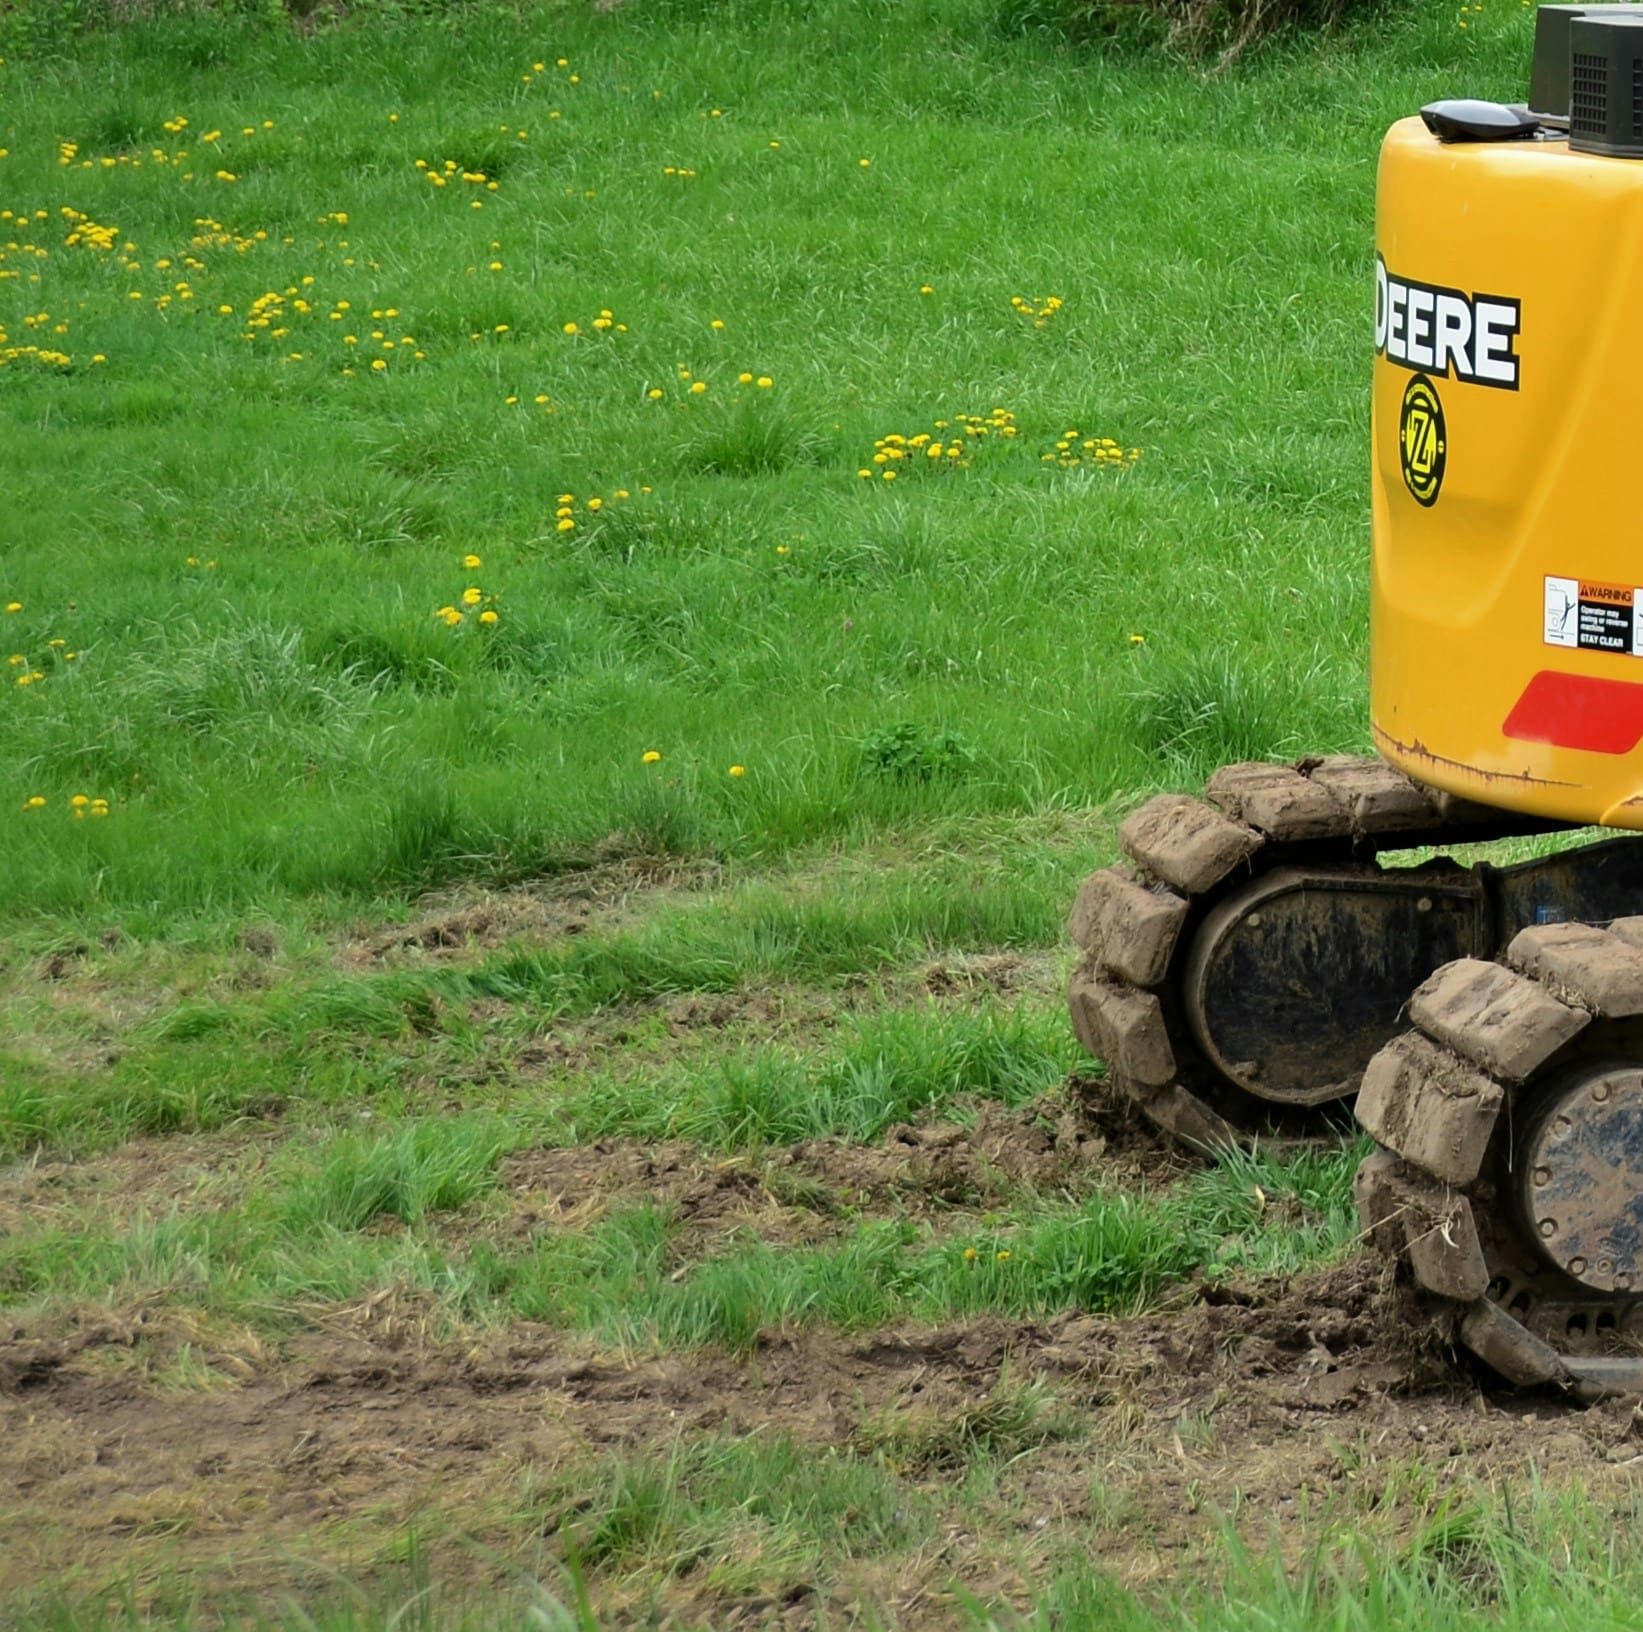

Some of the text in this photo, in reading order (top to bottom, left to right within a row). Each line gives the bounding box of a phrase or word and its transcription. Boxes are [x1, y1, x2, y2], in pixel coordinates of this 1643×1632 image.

[1375, 257, 1517, 382] DEERE
[1588, 586, 1632, 602] WARNING
[1580, 633, 1624, 648] STAY CLEAR
